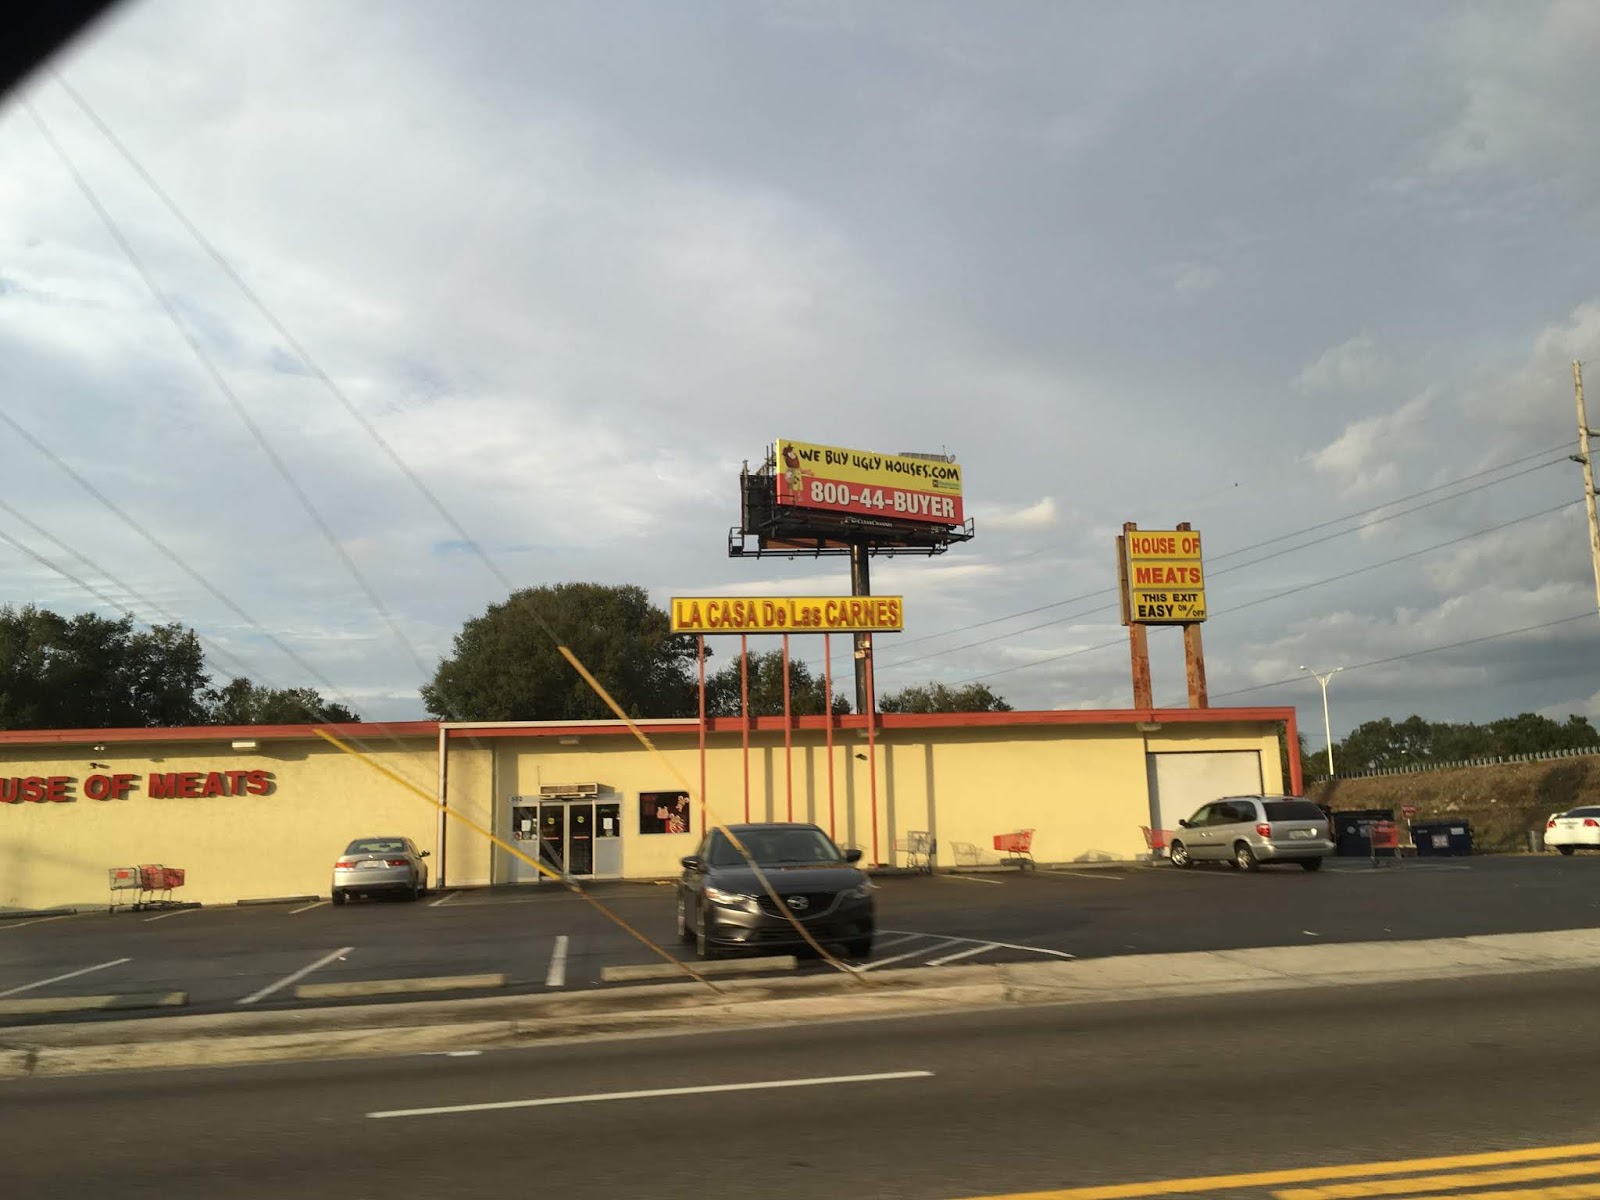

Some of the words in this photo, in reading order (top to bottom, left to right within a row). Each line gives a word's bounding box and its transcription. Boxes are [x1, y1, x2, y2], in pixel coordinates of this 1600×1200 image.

[799, 449, 821, 462] WE
[825, 450, 848, 465] BUY
[852, 455, 881, 471] UGLY
[811, 481, 956, 519] 800-44-BUYER
[1131, 537, 1176, 554] HOUSE
[1181, 537, 1200, 554] OF
[1136, 567, 1201, 584] MEATS
[1142, 593, 1167, 603] THIS
[1172, 593, 1198, 603] EXIT
[676, 601, 702, 628] LA
[705, 600, 760, 628] CASA
[790, 600, 822, 627] Las
[825, 600, 899, 627] CARNES
[1138, 604, 1174, 617] EASY
[0, 776, 72, 804] USE
[84, 774, 136, 801] OF
[148, 769, 270, 800] MEATS
